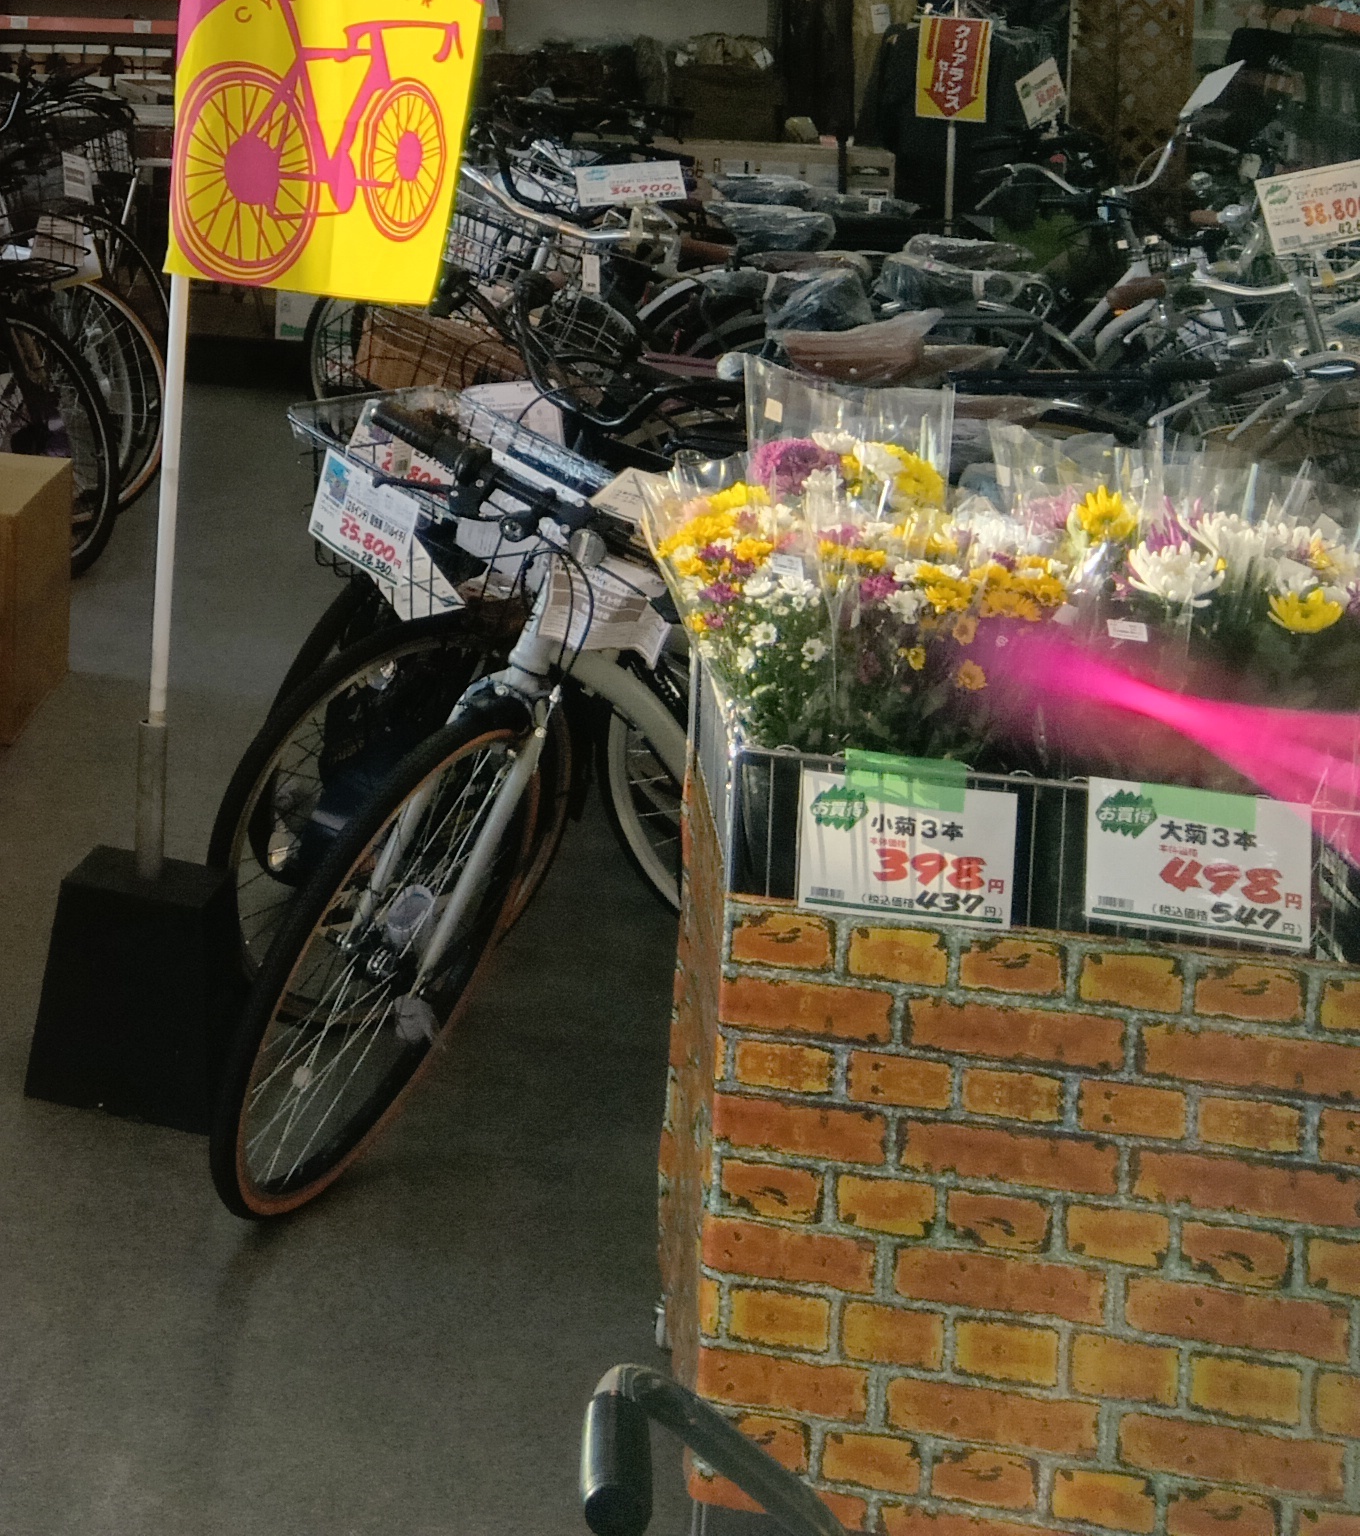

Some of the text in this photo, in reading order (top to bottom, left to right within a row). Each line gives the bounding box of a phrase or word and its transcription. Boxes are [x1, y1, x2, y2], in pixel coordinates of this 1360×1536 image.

[934, 59, 948, 92] セール
[945, 24, 971, 110] クリアランス
[812, 801, 863, 817] お買得
[1098, 807, 1153, 824] お買得
[871, 814, 963, 841] 小菊3本
[1161, 821, 1257, 851] 大菊3本
[870, 837, 906, 848] 本体価格
